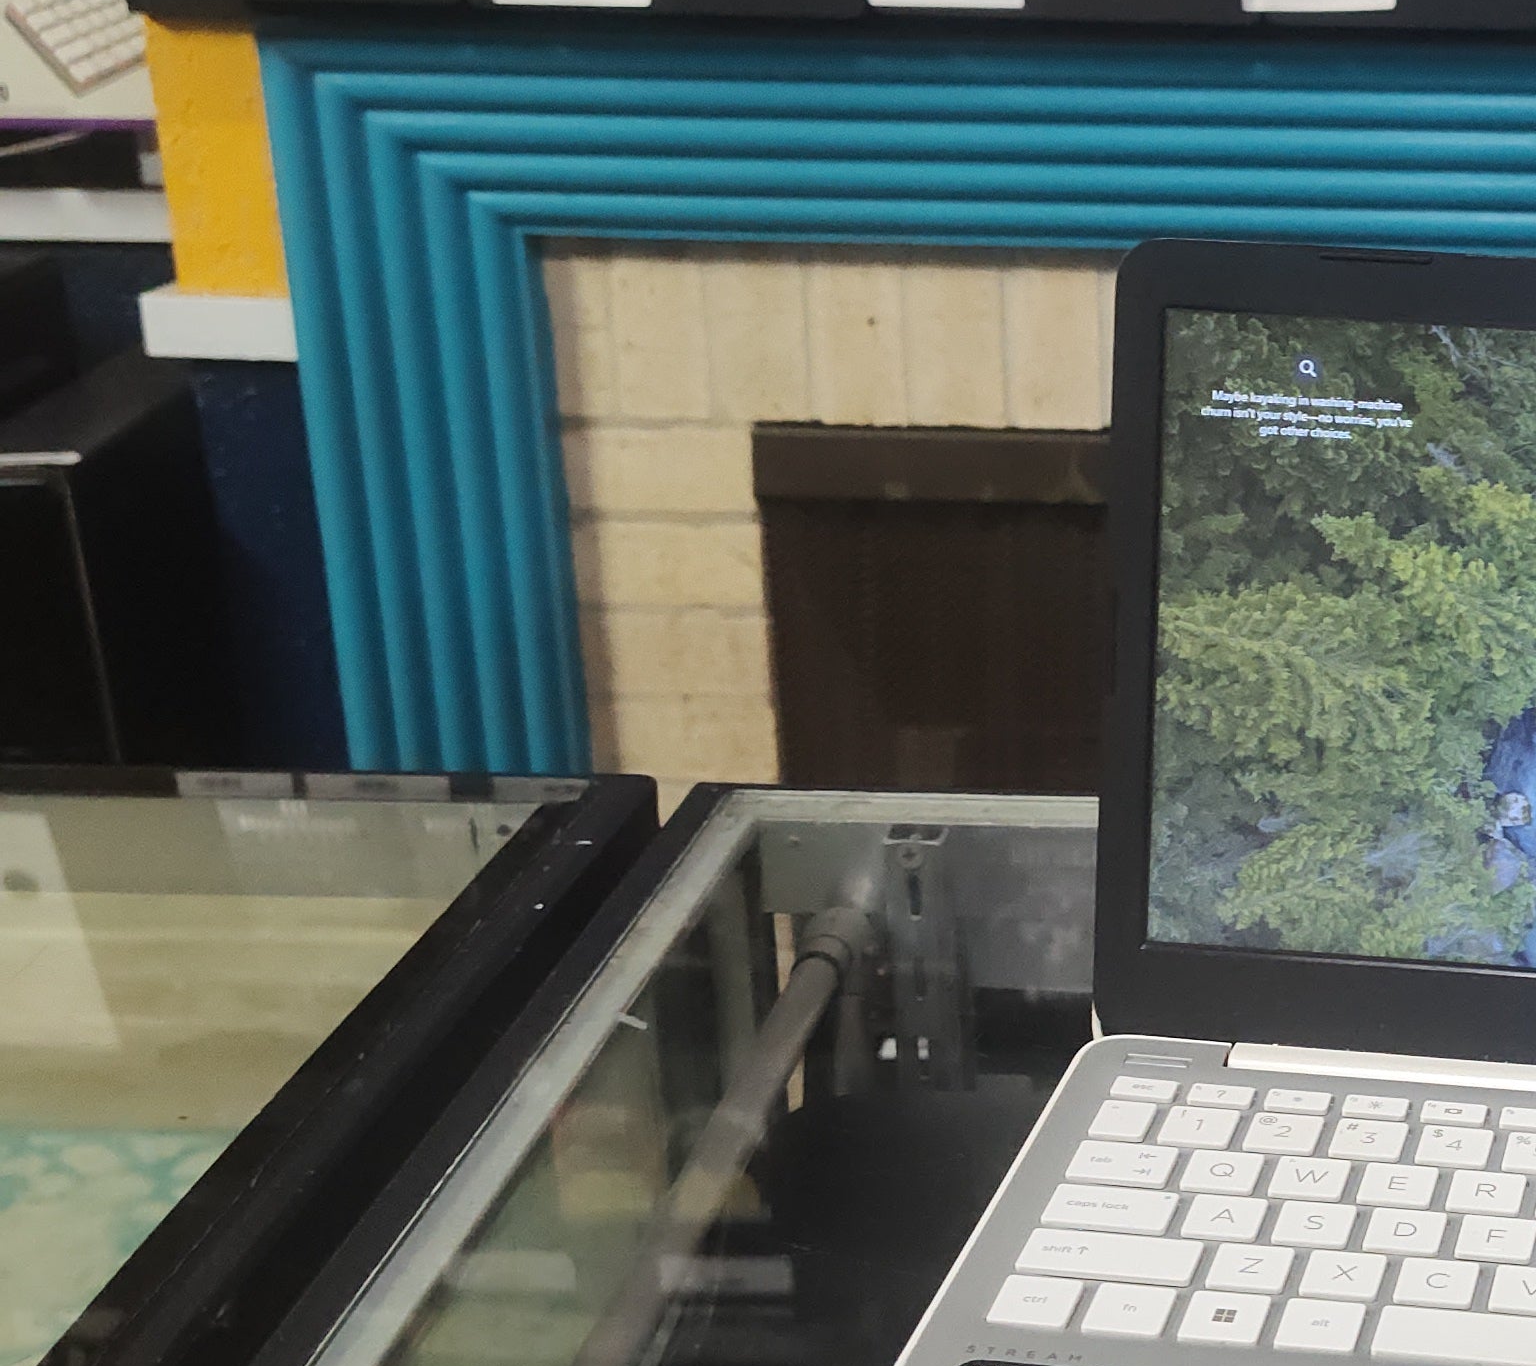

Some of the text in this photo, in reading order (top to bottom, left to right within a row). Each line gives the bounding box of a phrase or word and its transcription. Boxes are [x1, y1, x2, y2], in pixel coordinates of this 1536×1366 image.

[1212, 390, 1249, 404] Maybe
[1256, 411, 1281, 422] your
[1259, 426, 1279, 437] got
[1280, 427, 1309, 436] other
[1209, 1162, 1235, 1178] Q
[1295, 1168, 1329, 1184] W
[1387, 1175, 1409, 1191] E
[1474, 1183, 1497, 1199] R
[1066, 1197, 1095, 1209] caps
[965, 1345, 1084, 1362] STREAM
